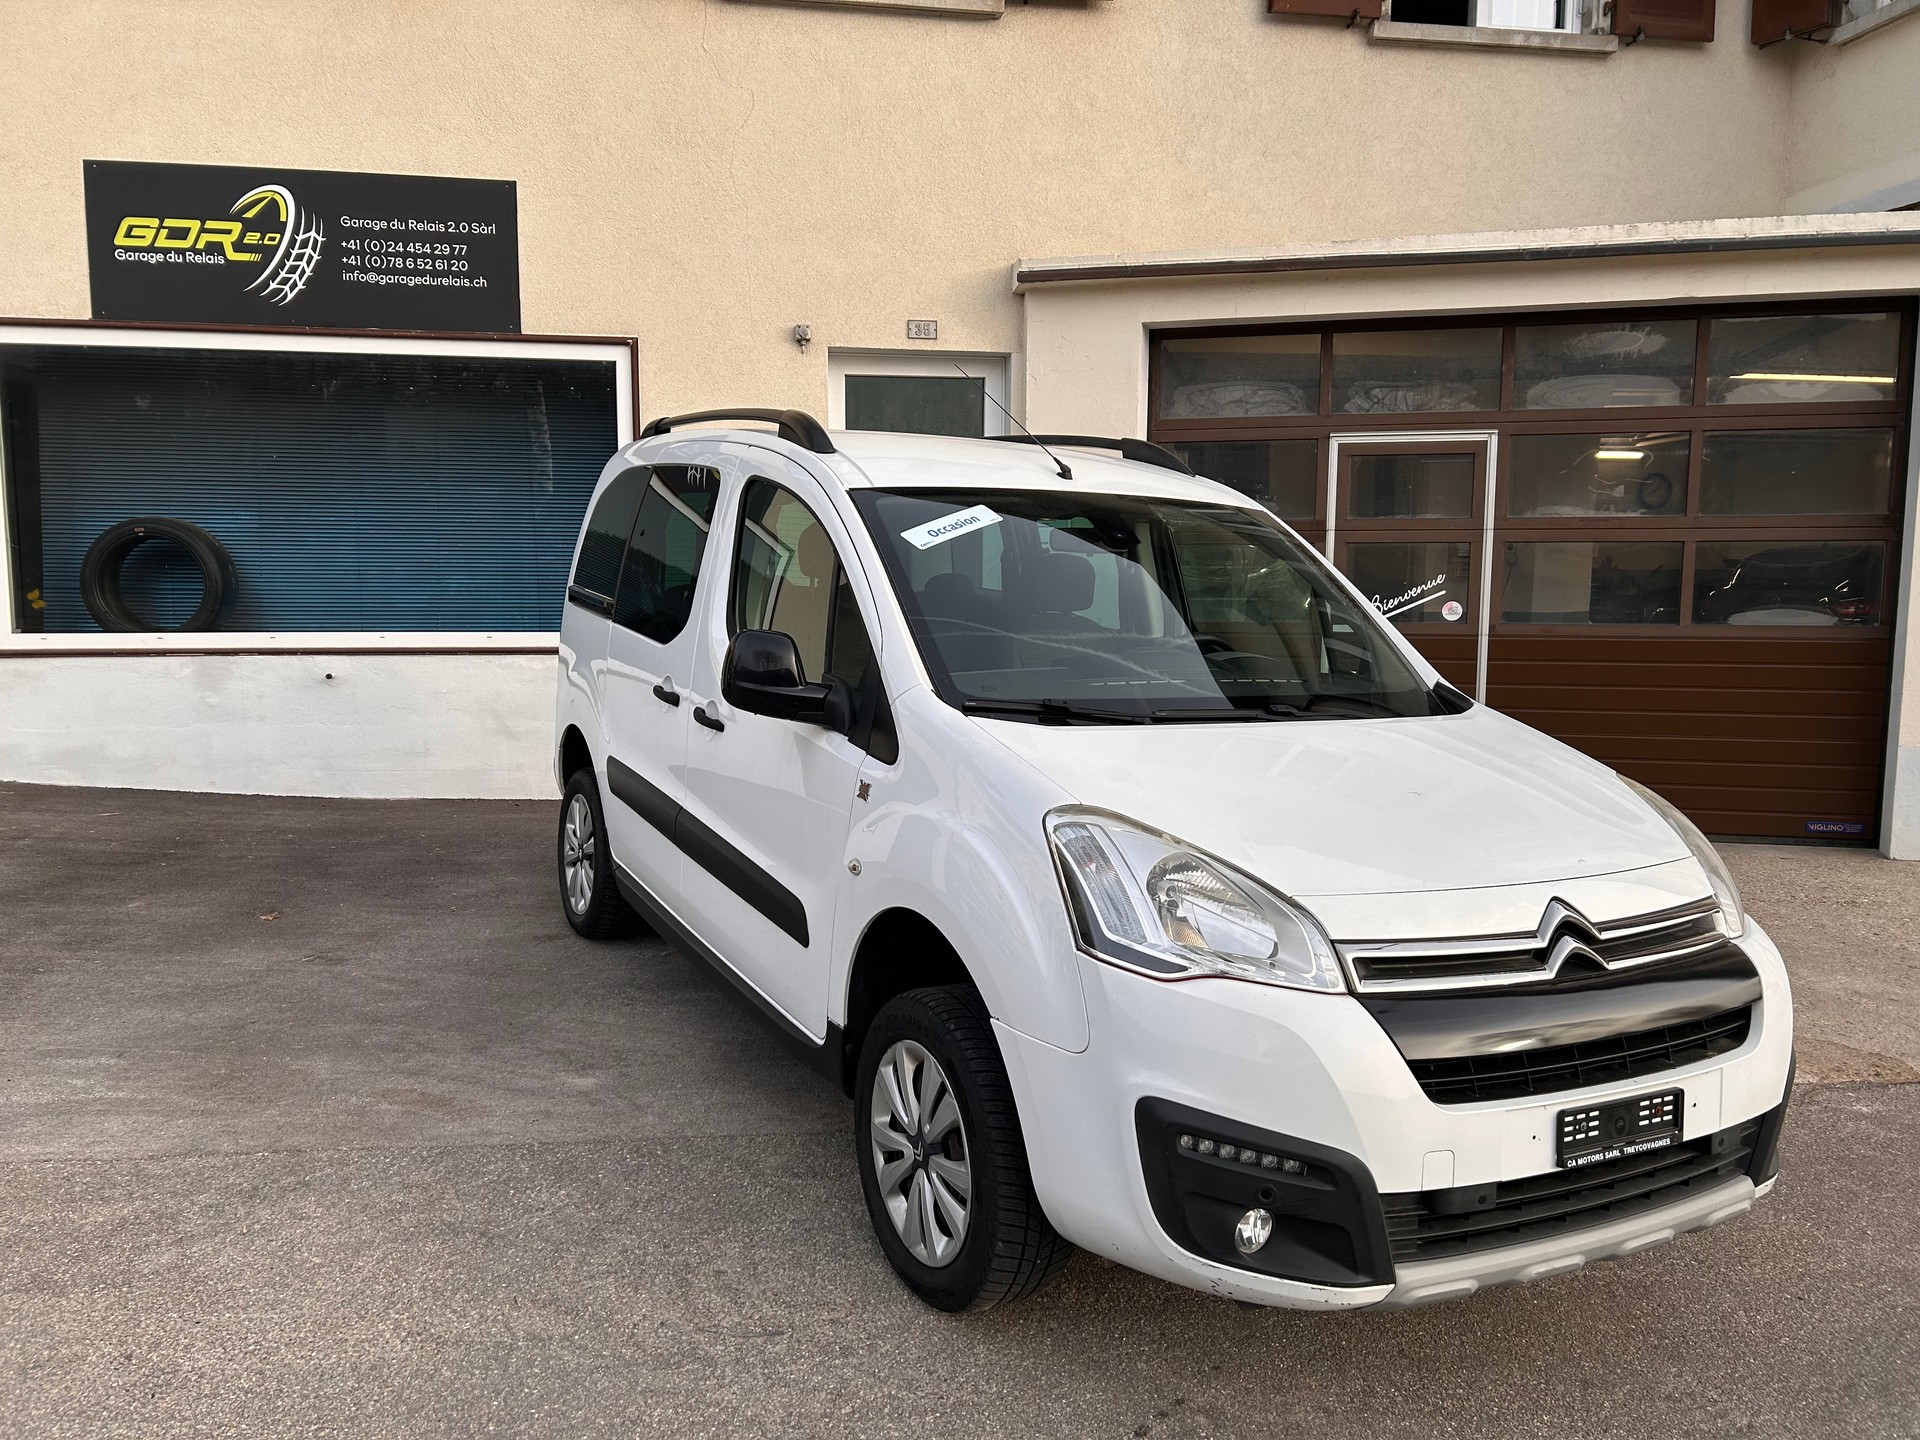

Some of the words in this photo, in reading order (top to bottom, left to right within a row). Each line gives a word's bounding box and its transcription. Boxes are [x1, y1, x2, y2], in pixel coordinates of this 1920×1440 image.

[340, 215, 388, 231] Garage
[389, 218, 406, 230] du
[408, 219, 446, 232] Relais
[447, 221, 469, 233] 2.0
[113, 216, 251, 262] GDR
[242, 232, 281, 246] 2.0
[341, 239, 360, 251] +41
[406, 242, 432, 254] 454
[433, 243, 451, 255] 29
[452, 244, 468, 256] 77
[114, 248, 165, 265] Garage
[166, 250, 183, 263] du
[186, 250, 225, 265] Relais
[341, 255, 361, 266] +41
[435, 259, 448, 270] 61
[450, 260, 469, 271] 20
[342, 270, 488, 288] info@garagedurelais.ch
[914, 322, 931, 337] 35
[926, 514, 981, 539] Occasion
[1370, 573, 1446, 615] Bienvenue
[1807, 823, 1844, 832] VIGLINO
[1567, 1159, 1577, 1168] CA
[1577, 1153, 1604, 1166] MOTORS
[1604, 1149, 1621, 1160] SARL
[1623, 1137, 1671, 1155] TREYCOVAGNES
